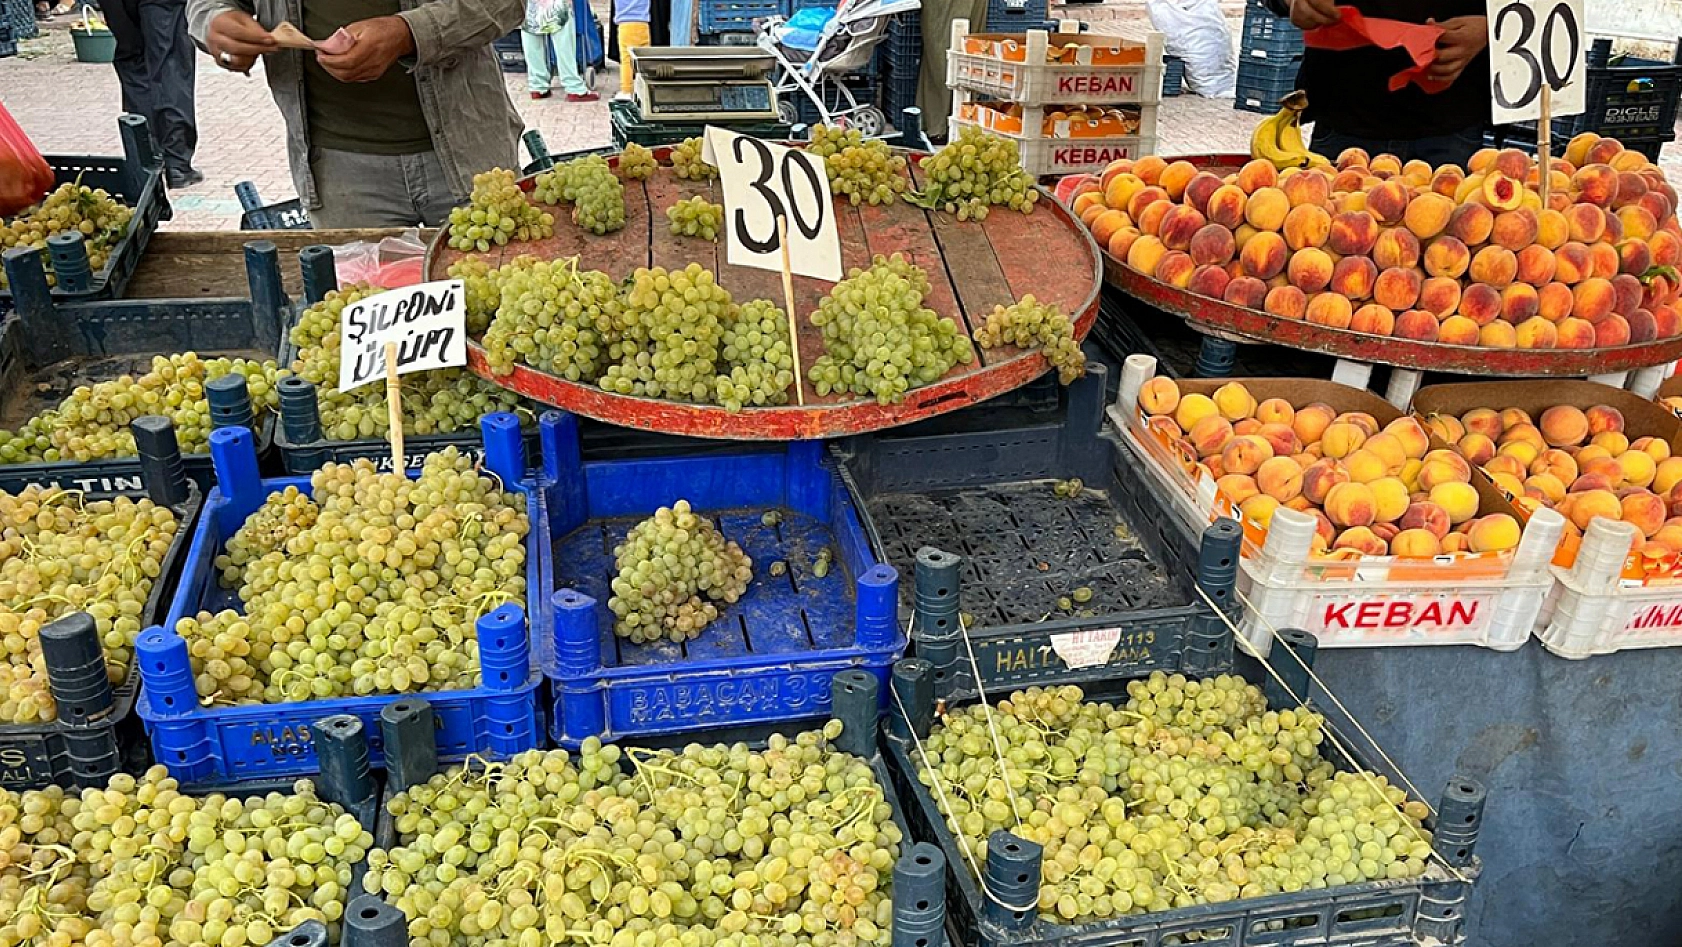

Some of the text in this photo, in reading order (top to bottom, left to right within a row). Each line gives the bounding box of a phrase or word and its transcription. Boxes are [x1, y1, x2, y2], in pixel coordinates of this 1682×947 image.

[1493, 2, 1580, 109] 30
[1058, 76, 1133, 93] KEBAN
[1054, 148, 1129, 165] KEBAN
[732, 136, 824, 255] 30
[1323, 601, 1479, 628] KEBAN
[783, 673, 833, 708] 33
